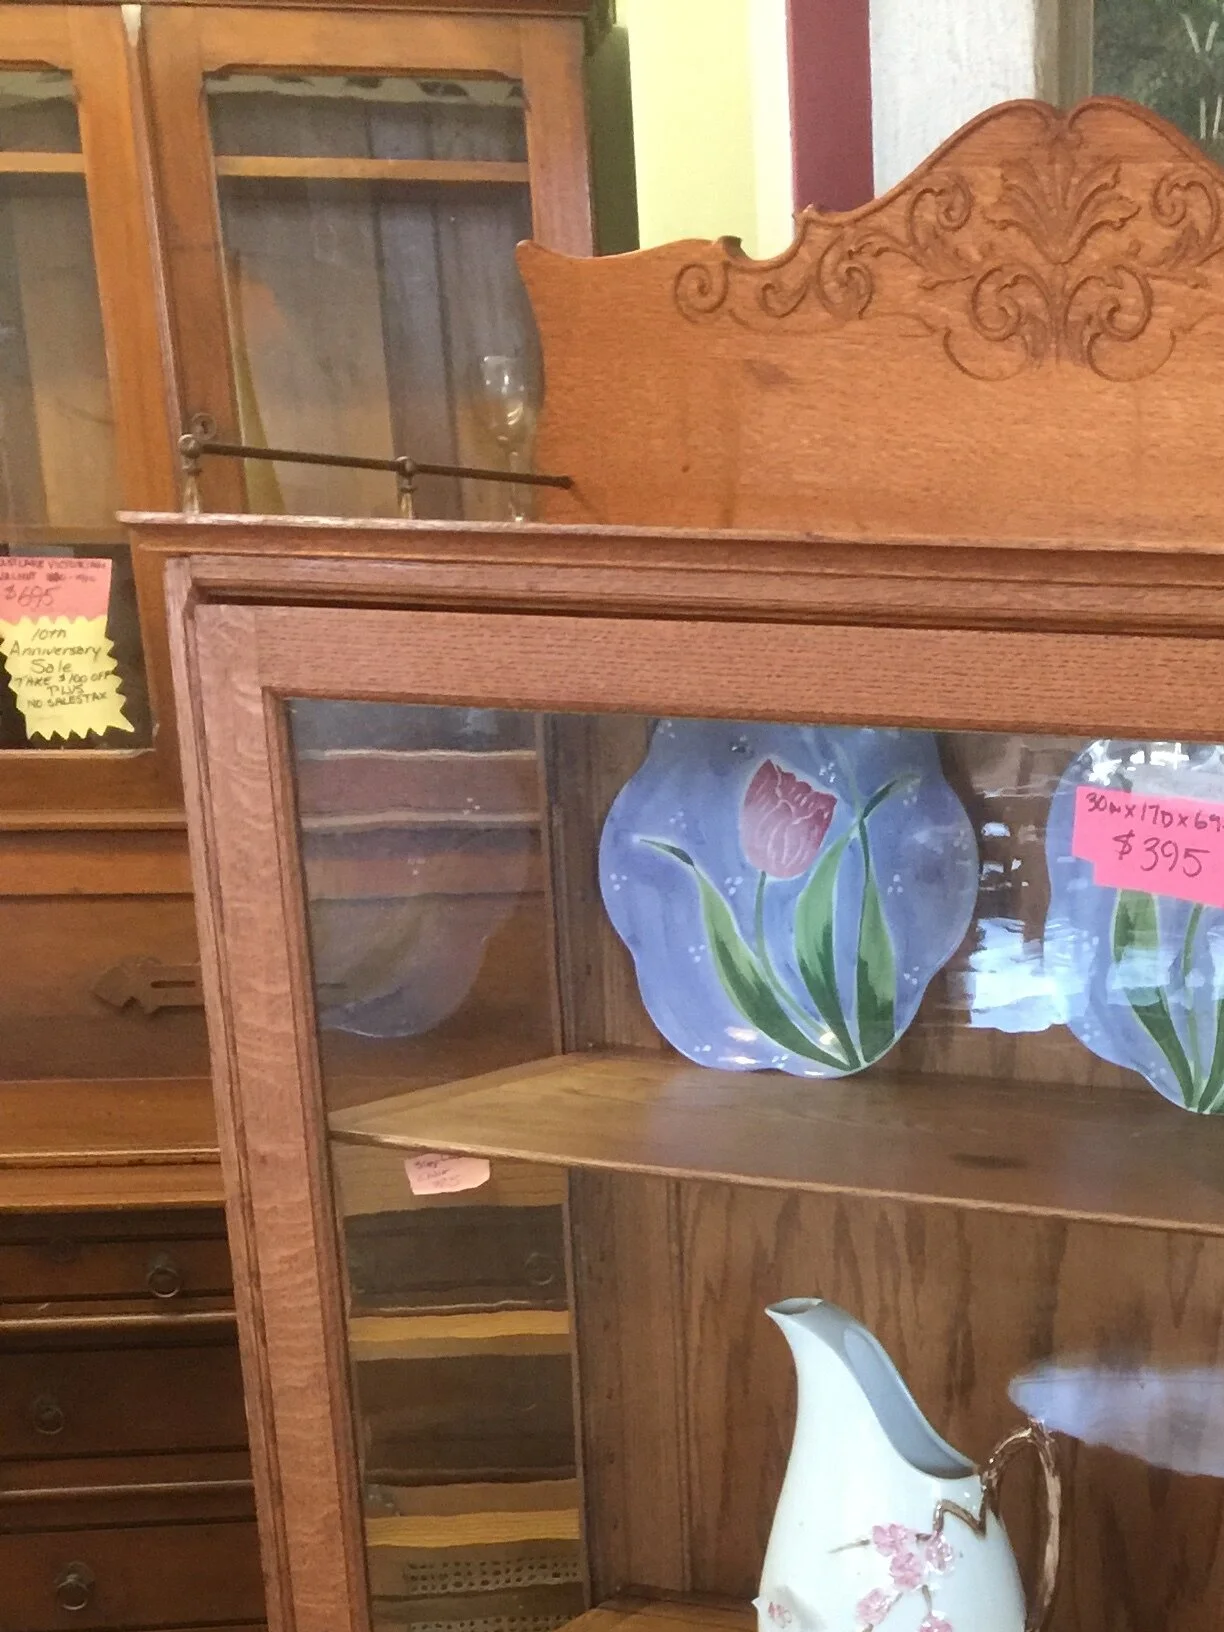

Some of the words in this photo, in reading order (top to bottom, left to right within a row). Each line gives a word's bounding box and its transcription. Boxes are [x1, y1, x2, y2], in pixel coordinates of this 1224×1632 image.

[4, 584, 62, 608] $695
[10, 640, 101, 661] Anniversary
[30, 658, 72, 674] Sale
[14, 674, 52, 686] TAKE
[90, 670, 112, 681] OFF
[47, 684, 84, 696] PLUS
[27, 699, 42, 708] NO
[1112, 829, 1211, 878] $395
